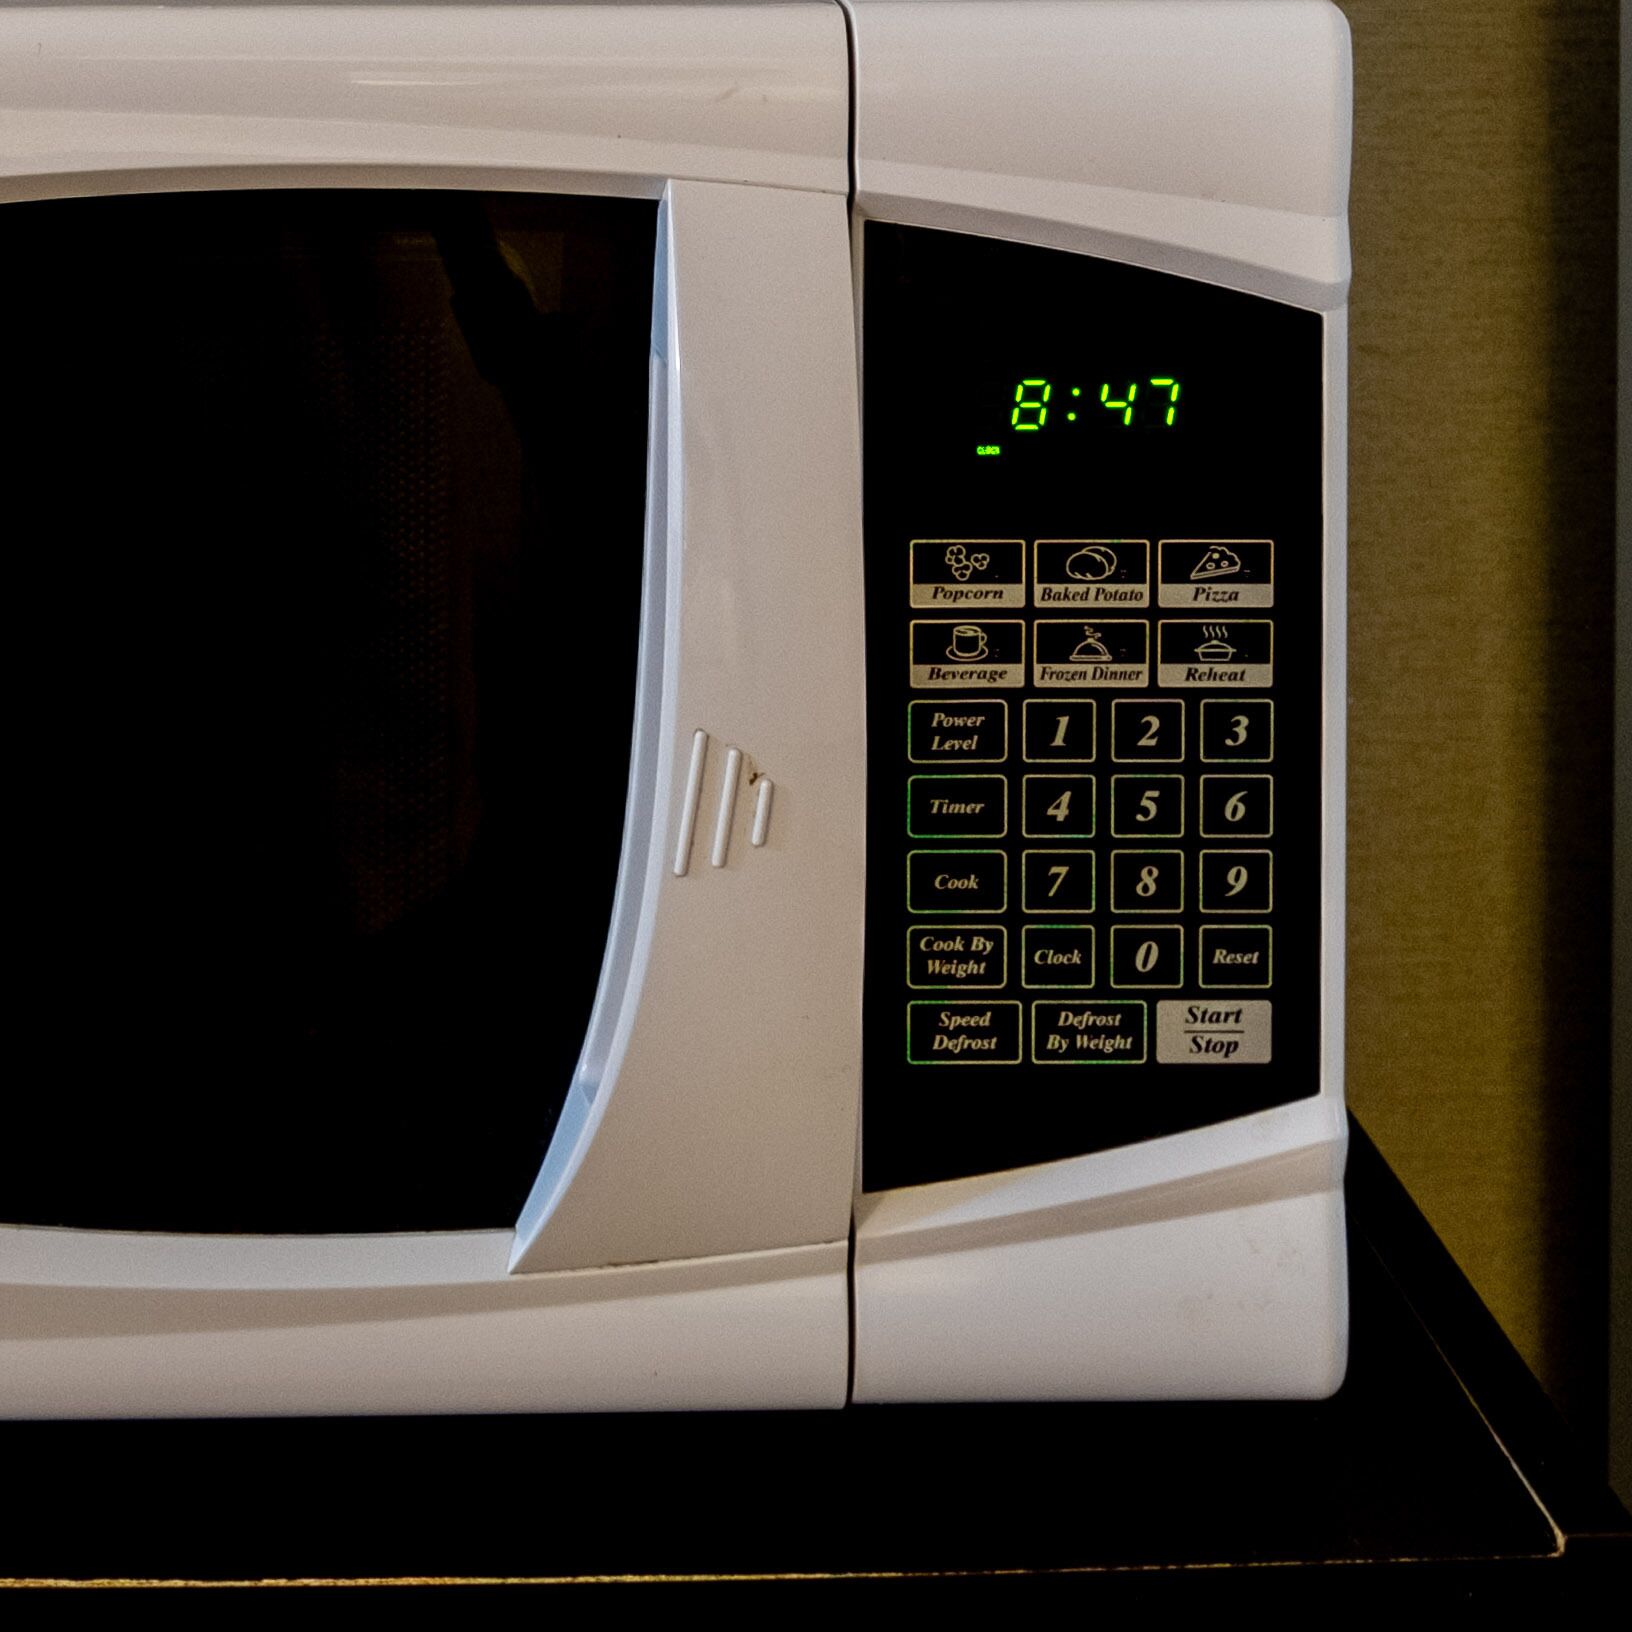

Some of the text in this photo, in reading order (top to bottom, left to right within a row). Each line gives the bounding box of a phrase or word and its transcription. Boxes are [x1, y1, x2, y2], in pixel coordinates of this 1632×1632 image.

[1011, 378, 1181, 431] 8:47
[932, 586, 1005, 603] Popcorn
[1040, 587, 1144, 603] Baked Potato
[1192, 587, 1240, 603] Pizza
[928, 666, 1008, 683] Beverage
[1039, 666, 1143, 682] Frozen Dinner
[1184, 667, 1246, 682] Reheat
[931, 712, 986, 729] Power
[1049, 715, 1070, 747] 1
[1136, 715, 1161, 747] 2
[1224, 715, 1250, 747] 3
[931, 735, 979, 751] Level
[929, 799, 985, 815] Timer
[1046, 790, 1073, 822] 4
[1135, 790, 1160, 822] 5
[1223, 790, 1249, 822] 6
[934, 874, 980, 891] Cook
[1047, 866, 1070, 898] 7
[1135, 865, 1160, 897] 8
[1223, 865, 1249, 898] 9
[919, 936, 995, 956] Cook By
[1033, 949, 1082, 965] Clock
[1134, 941, 1160, 973] 0
[1212, 948, 1260, 965] Reset
[926, 959, 987, 978] Weight
[938, 1011, 992, 1030] Speed
[1058, 1011, 1123, 1029] Defrost
[1184, 1006, 1243, 1025] Start
[932, 1034, 998, 1052] Defrost
[1046, 1034, 1133, 1053] By Weight
[1189, 1035, 1240, 1058] Stop
